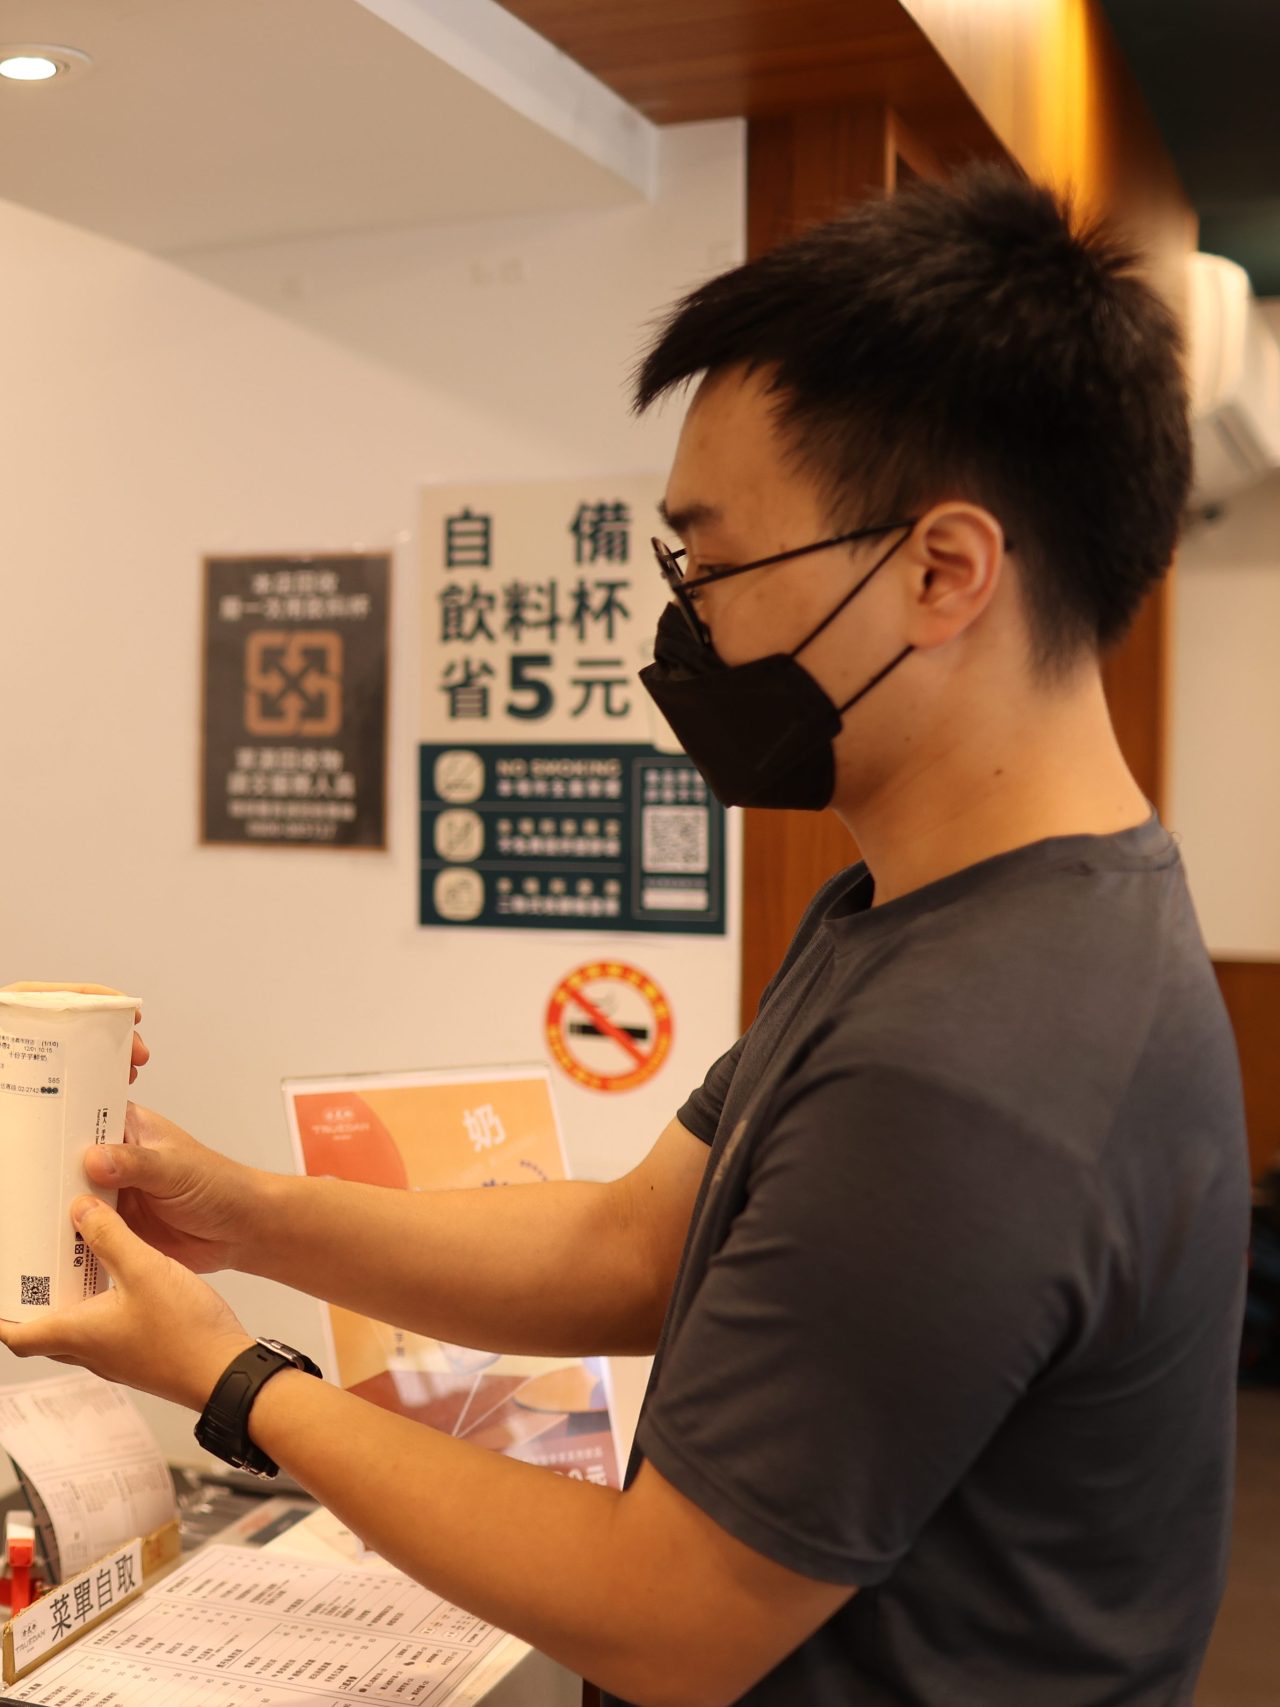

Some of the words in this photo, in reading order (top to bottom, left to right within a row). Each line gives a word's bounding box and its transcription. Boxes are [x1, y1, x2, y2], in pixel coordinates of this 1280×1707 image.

[439, 577, 631, 645] 飲料杯
[439, 653, 631, 721] 省5元
[463, 1103, 506, 1152] 奶
[49, 1554, 136, 1642] 菜單自取
